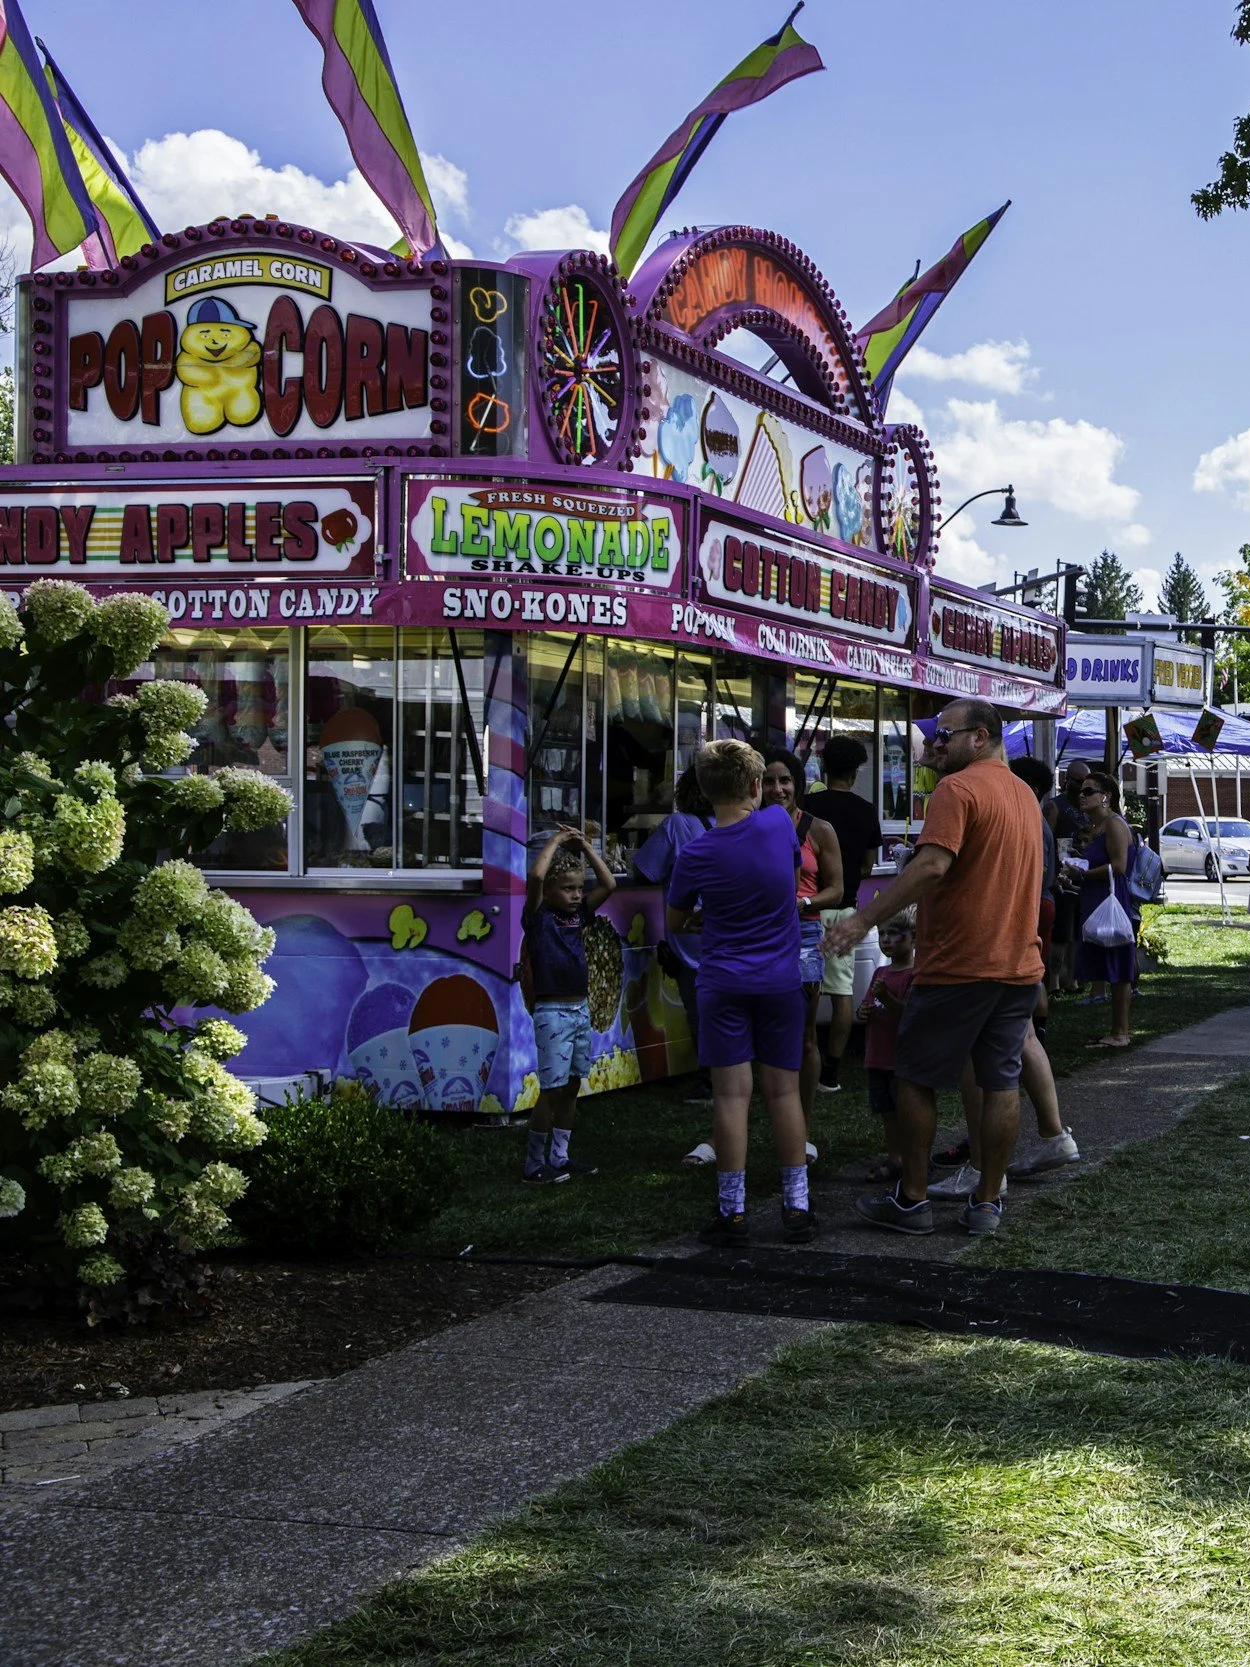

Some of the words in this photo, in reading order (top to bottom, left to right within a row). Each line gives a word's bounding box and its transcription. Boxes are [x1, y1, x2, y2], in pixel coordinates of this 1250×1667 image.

[172, 258, 264, 292] CARAMEL
[270, 259, 323, 289] CORN
[669, 248, 748, 332] CANDY
[68, 310, 178, 427] POP
[262, 295, 429, 437] CORN
[487, 491, 546, 505] FRESH
[552, 496, 636, 518] SQUEEZED
[119, 501, 319, 564] APPLES
[431, 496, 670, 571] LEMONADE
[470, 559, 646, 582] SHAKE-UPS
[724, 535, 824, 615] COTTON
[831, 567, 898, 632] CANDY
[279, 588, 380, 617] CANDY
[671, 603, 737, 643] POPCORN
[943, 606, 994, 659] CANDY
[1001, 623, 1051, 673] APPLES
[758, 624, 788, 654] COLD
[789, 633, 832, 663] DRINKS
[847, 646, 879, 674] CANDY
[926, 664, 956, 690] COTTON
[956, 671, 980, 696] CANDY
[1081, 658, 1139, 683] DRINKS
[1154, 658, 1174, 687] FRIED
[324, 750, 341, 758] BLUE
[342, 749, 379, 758] RASPBERRY
